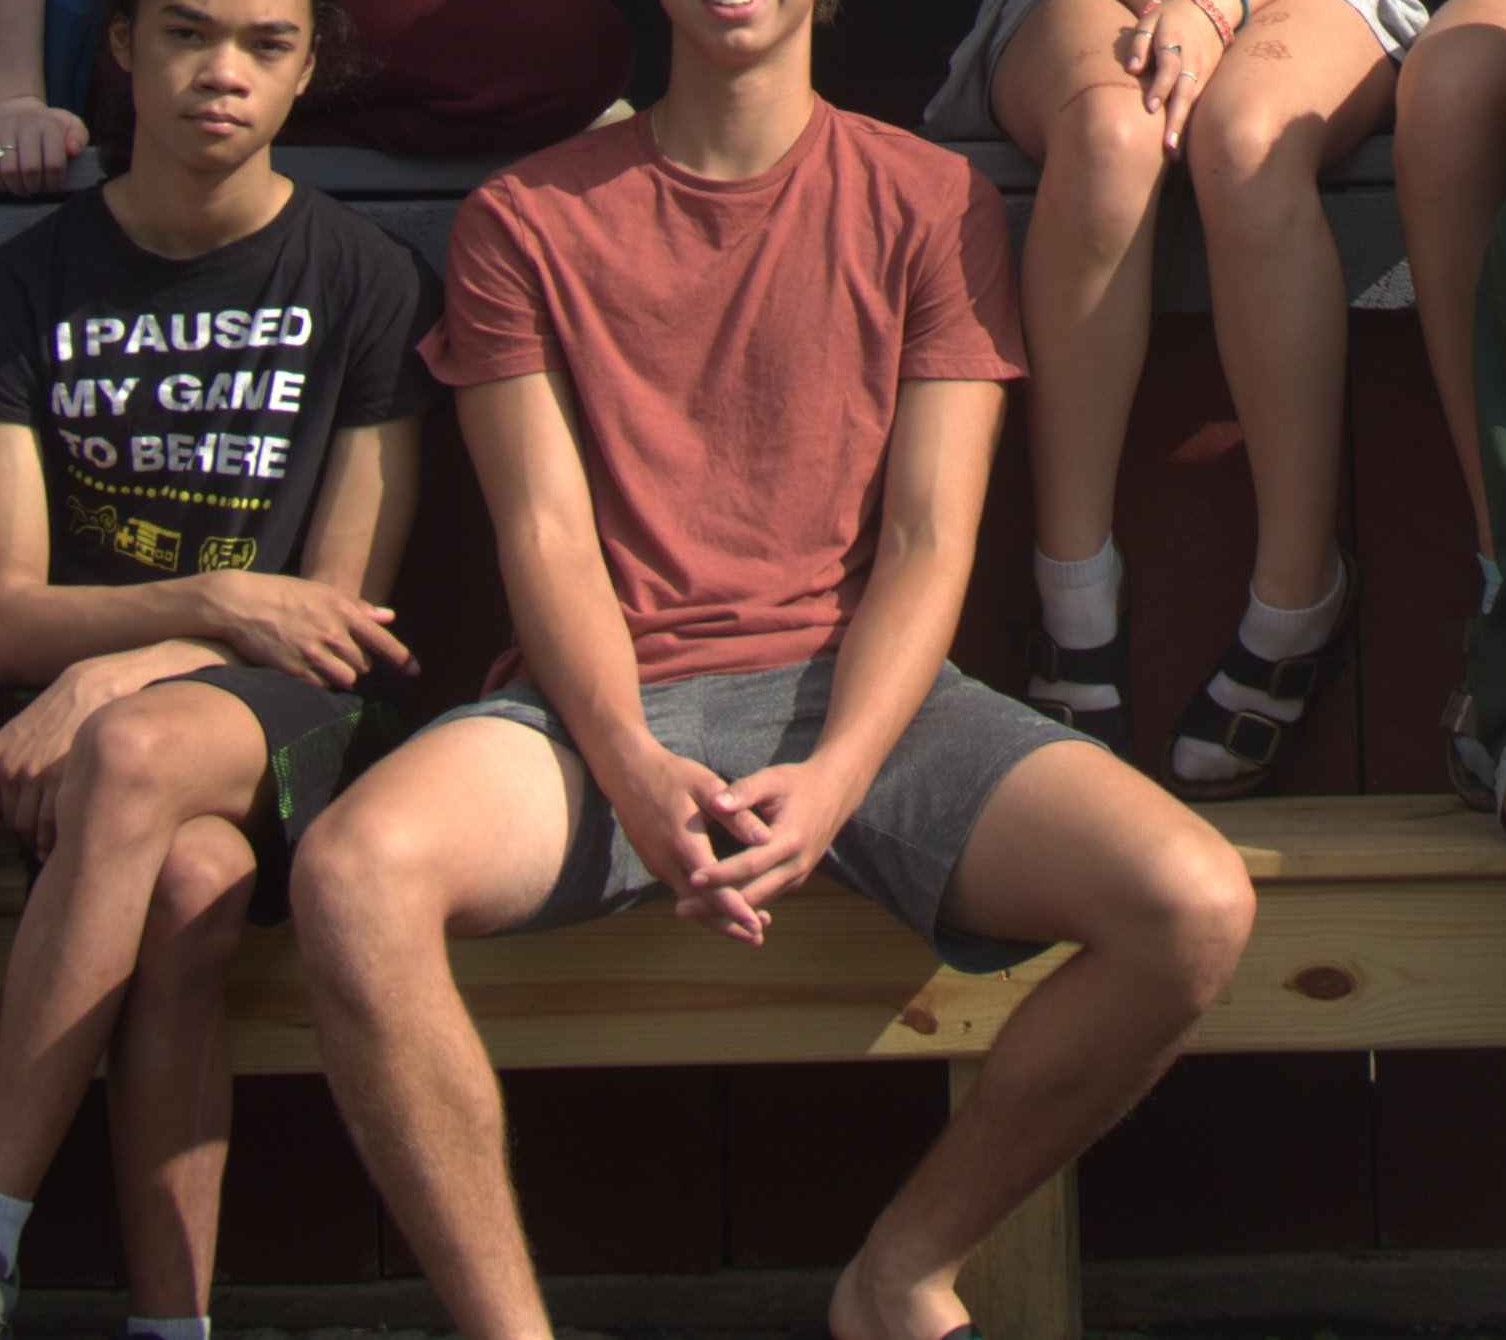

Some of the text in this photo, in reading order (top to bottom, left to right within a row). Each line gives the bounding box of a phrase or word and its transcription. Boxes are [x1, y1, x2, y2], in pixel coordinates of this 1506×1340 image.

[53, 305, 313, 362] I PAUSED
[50, 376, 140, 419] MY
[57, 428, 119, 470] TO
[130, 432, 196, 473] BE
